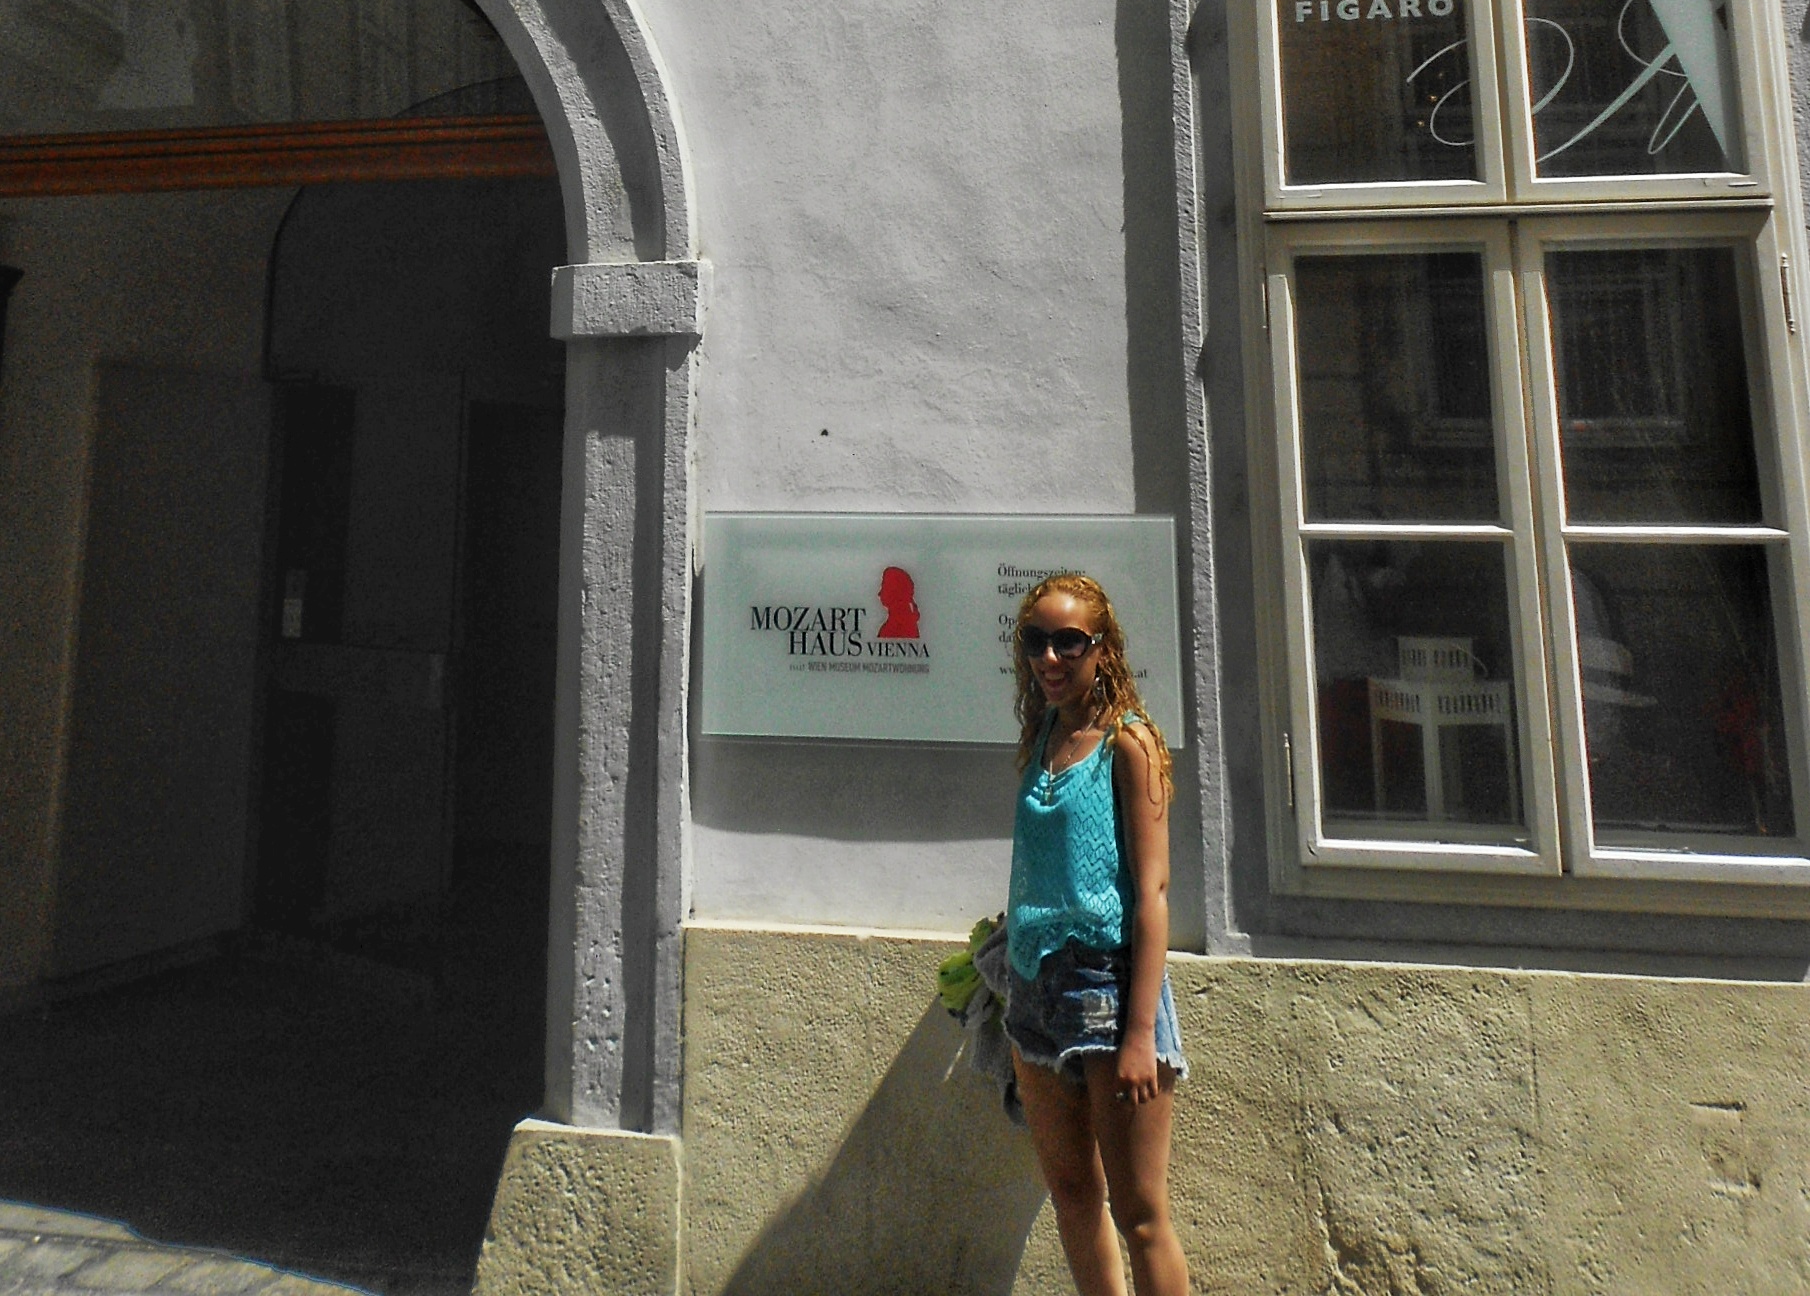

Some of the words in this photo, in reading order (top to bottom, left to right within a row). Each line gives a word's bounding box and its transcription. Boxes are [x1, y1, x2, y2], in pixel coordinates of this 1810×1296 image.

[750, 606, 867, 632] MOZART
[789, 630, 863, 657] HAUS
[867, 641, 930, 658] VIENNA
